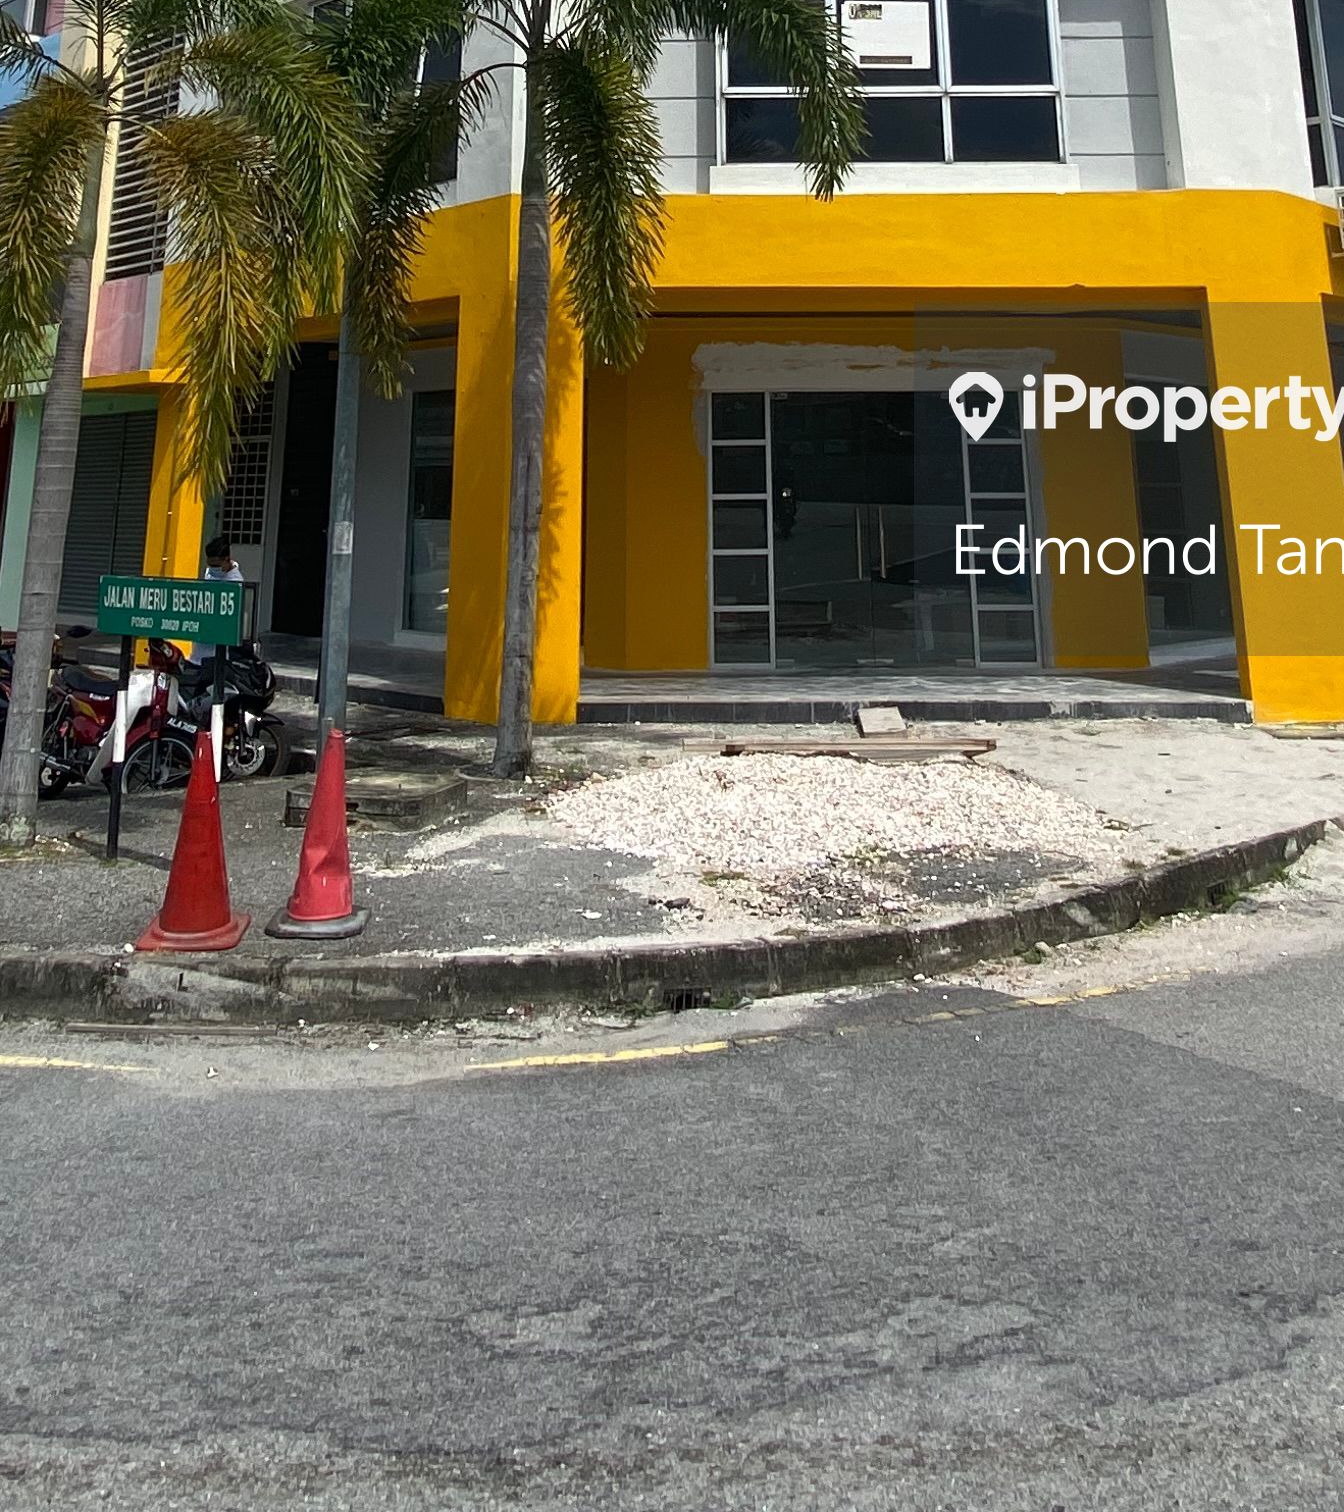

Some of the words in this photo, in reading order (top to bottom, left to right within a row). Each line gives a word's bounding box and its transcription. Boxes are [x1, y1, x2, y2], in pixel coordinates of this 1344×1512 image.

[104, 585, 135, 609] JALAN
[139, 587, 168, 612] MERU
[172, 588, 215, 615] BESTARI
[220, 591, 235, 616] B5
[182, 620, 200, 633] IPOH
